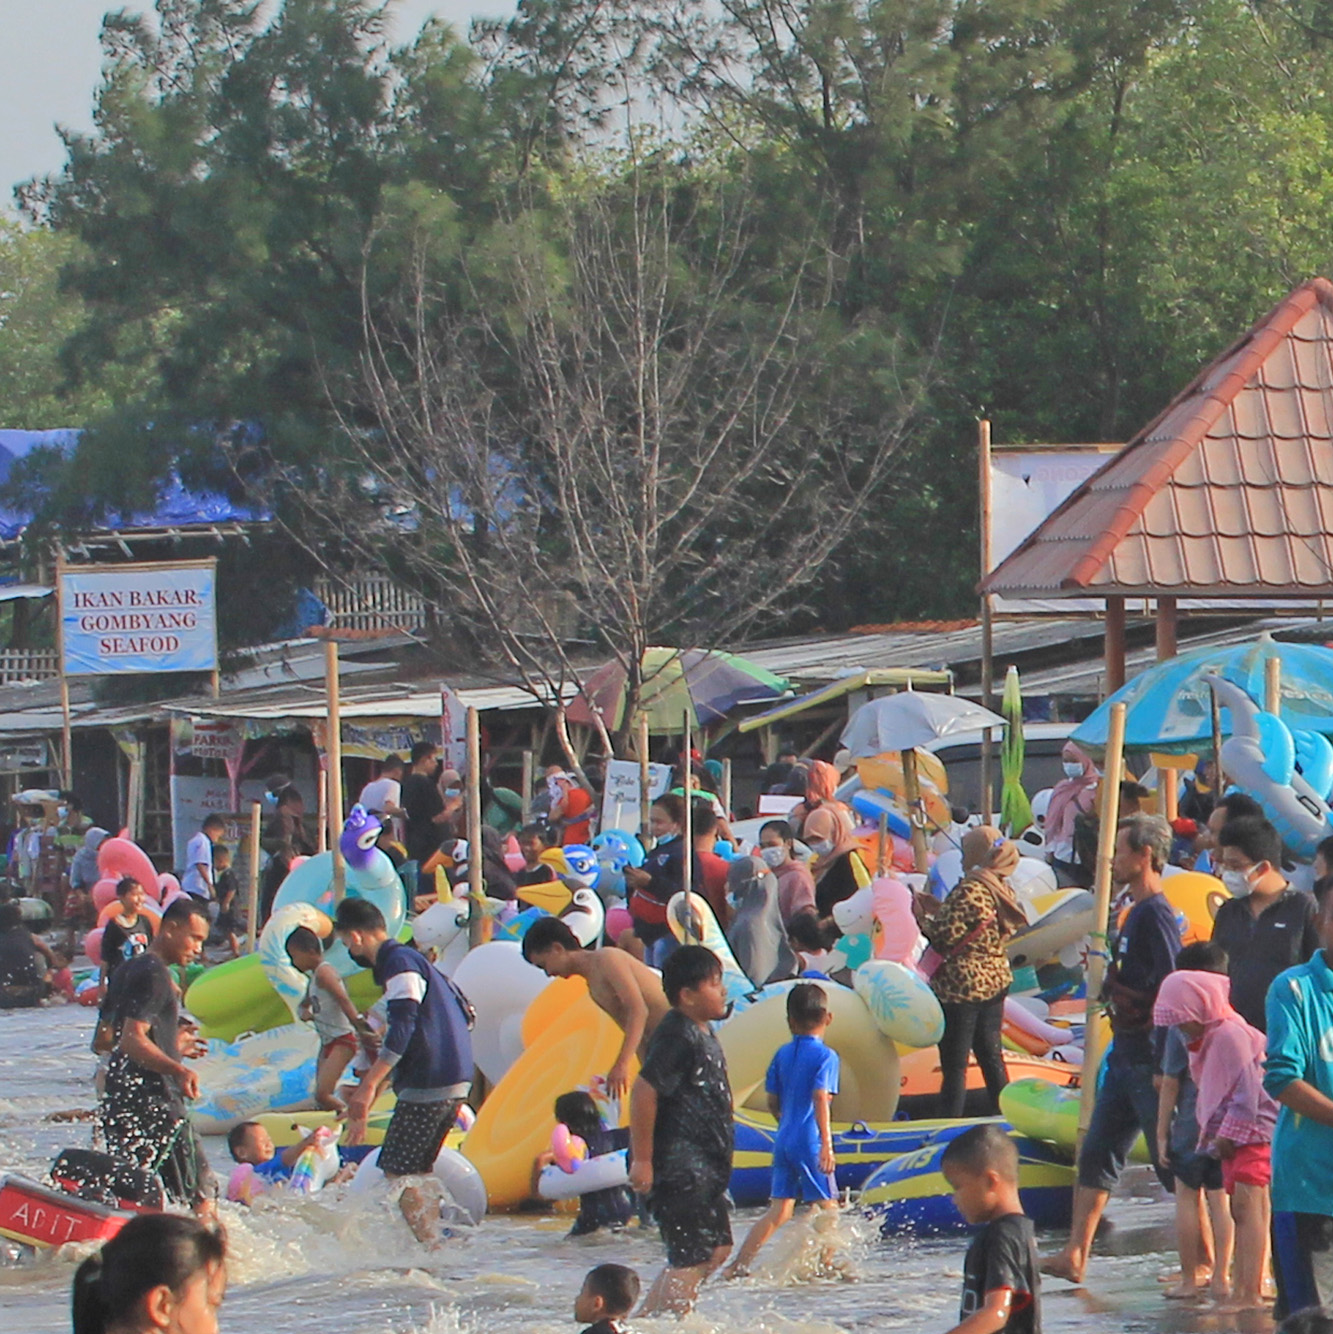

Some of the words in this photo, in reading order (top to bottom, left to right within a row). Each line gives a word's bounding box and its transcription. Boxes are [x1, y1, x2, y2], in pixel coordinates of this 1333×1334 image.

[74, 591, 123, 608] IKAN
[129, 589, 202, 606] BAKAR,
[81, 612, 196, 631] GOMBYANG
[100, 636, 179, 653] SEAFOD
